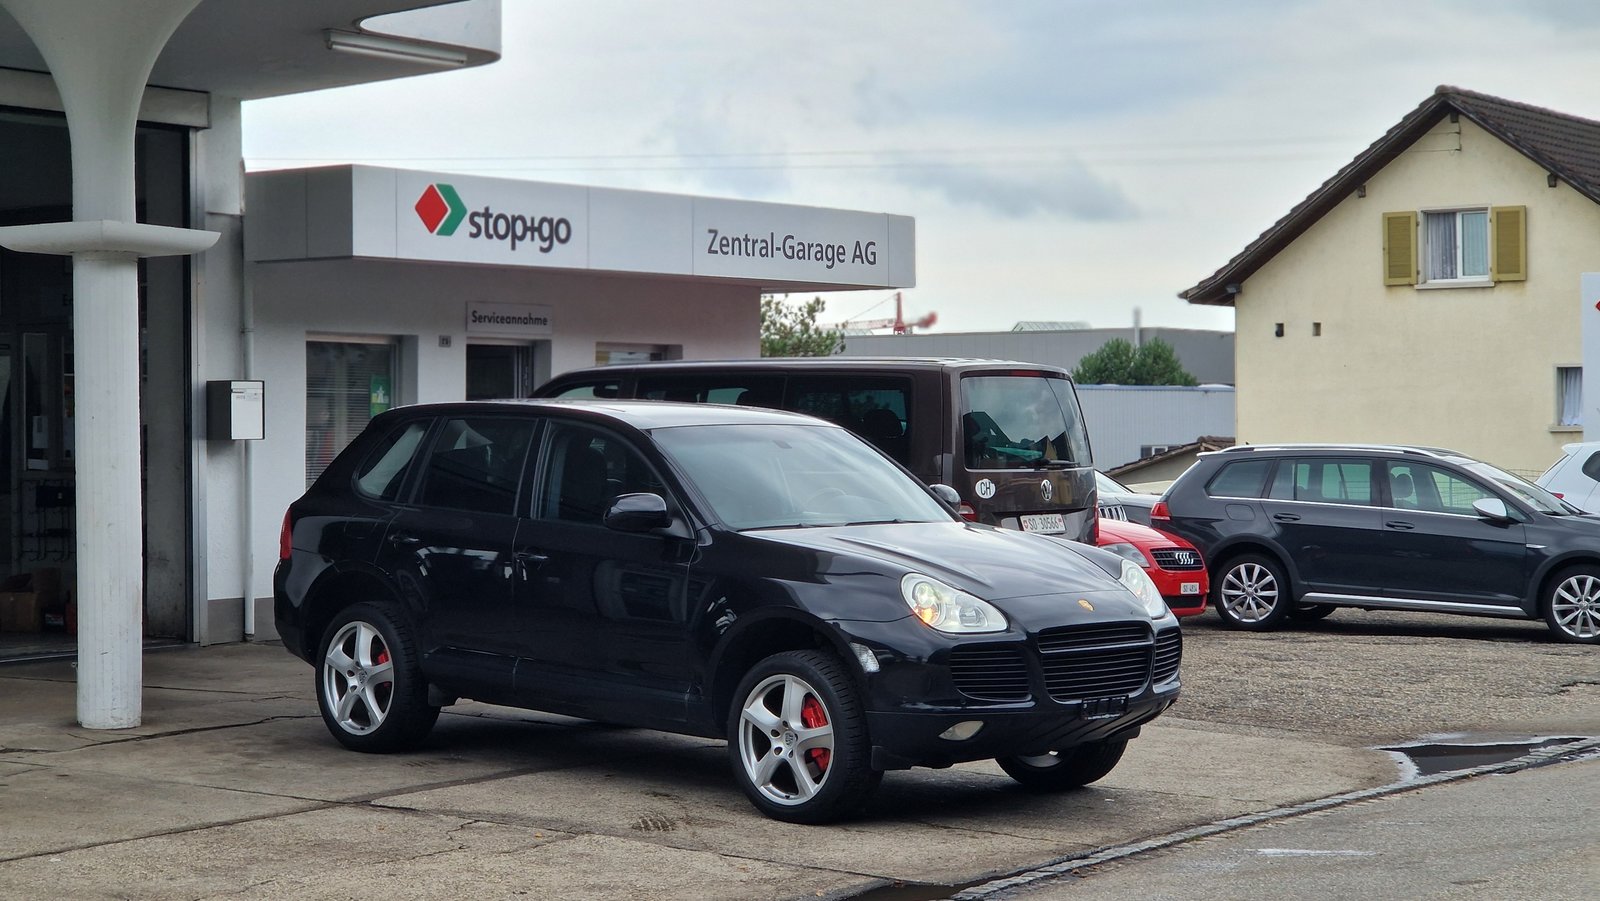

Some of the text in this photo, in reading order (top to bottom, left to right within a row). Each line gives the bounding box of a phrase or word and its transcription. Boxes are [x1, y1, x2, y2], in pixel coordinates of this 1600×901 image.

[468, 206, 572, 253] stop+go
[707, 228, 877, 269] Zentral-Garage AG
[471, 309, 548, 326] Serviceannahme
[980, 481, 992, 496] CH
